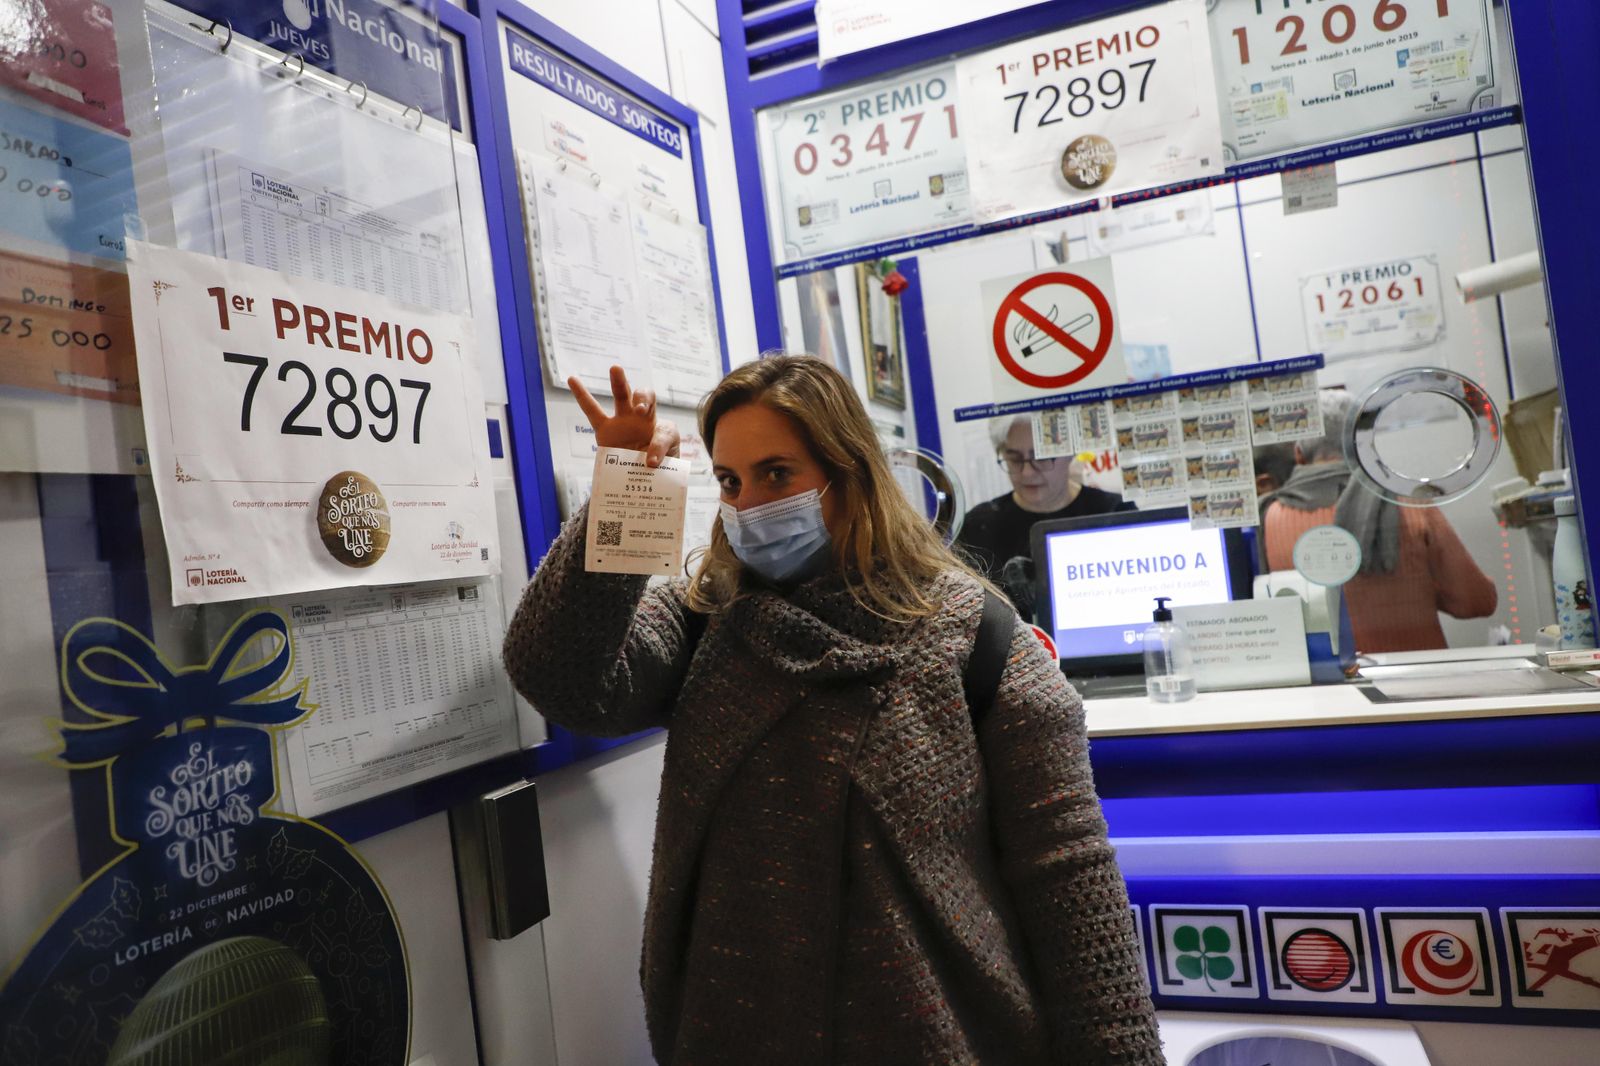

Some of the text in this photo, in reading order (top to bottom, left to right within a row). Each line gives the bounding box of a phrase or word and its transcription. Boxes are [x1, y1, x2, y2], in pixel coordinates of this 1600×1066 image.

[269, 20, 331, 60] JUEVES
[324, 0, 443, 73] Nacional
[1271, 60, 1296, 73] Sorteo
[1352, 46, 1362, 54] de
[1363, 40, 1384, 53] junio
[1398, 31, 1419, 42] 2019
[995, 25, 1160, 85] 1er PREMIO
[512, 42, 682, 151] RESULTADOS SORTEOS
[841, 78, 947, 126] PREMIO
[1004, 58, 1157, 134] 72897
[1344, 80, 1395, 98] Nacional
[793, 103, 959, 176] 03471
[1423, 121, 1464, 136] Apuestas
[1466, 117, 1480, 126] del
[1482, 111, 1513, 123] Estado
[882, 191, 920, 207] Nacional
[1341, 263, 1412, 285] PREMIO
[1316, 277, 1424, 313] 12061
[207, 286, 433, 364] 1er PREMIO
[1288, 359, 1316, 369] Estado
[223, 352, 431, 445] 72897
[232, 500, 265, 509] Compartir
[284, 500, 309, 509] siempre
[341, 509, 380, 531] QUE NOS
[338, 528, 373, 558] UNE
[206, 568, 238, 578] LOTERÍA
[207, 576, 247, 586] NACIONAL
[1067, 552, 1208, 581] BIENVENIDO A
[1177, 579, 1211, 589] Estado
[1186, 614, 1269, 628] ESTIMADOS ABONADOS
[1244, 629, 1257, 637] que
[1259, 627, 1277, 635] estar
[1234, 640, 1260, 650] HORAS
[1245, 653, 1272, 662] Gracias
[146, 760, 253, 837] SORTEO
[175, 794, 254, 839] QUE NOS
[166, 828, 238, 887] UNE
[169, 884, 249, 921] 22 DICIEMBRE
[115, 888, 295, 966] LOTERÍA DE NAVIDAD
